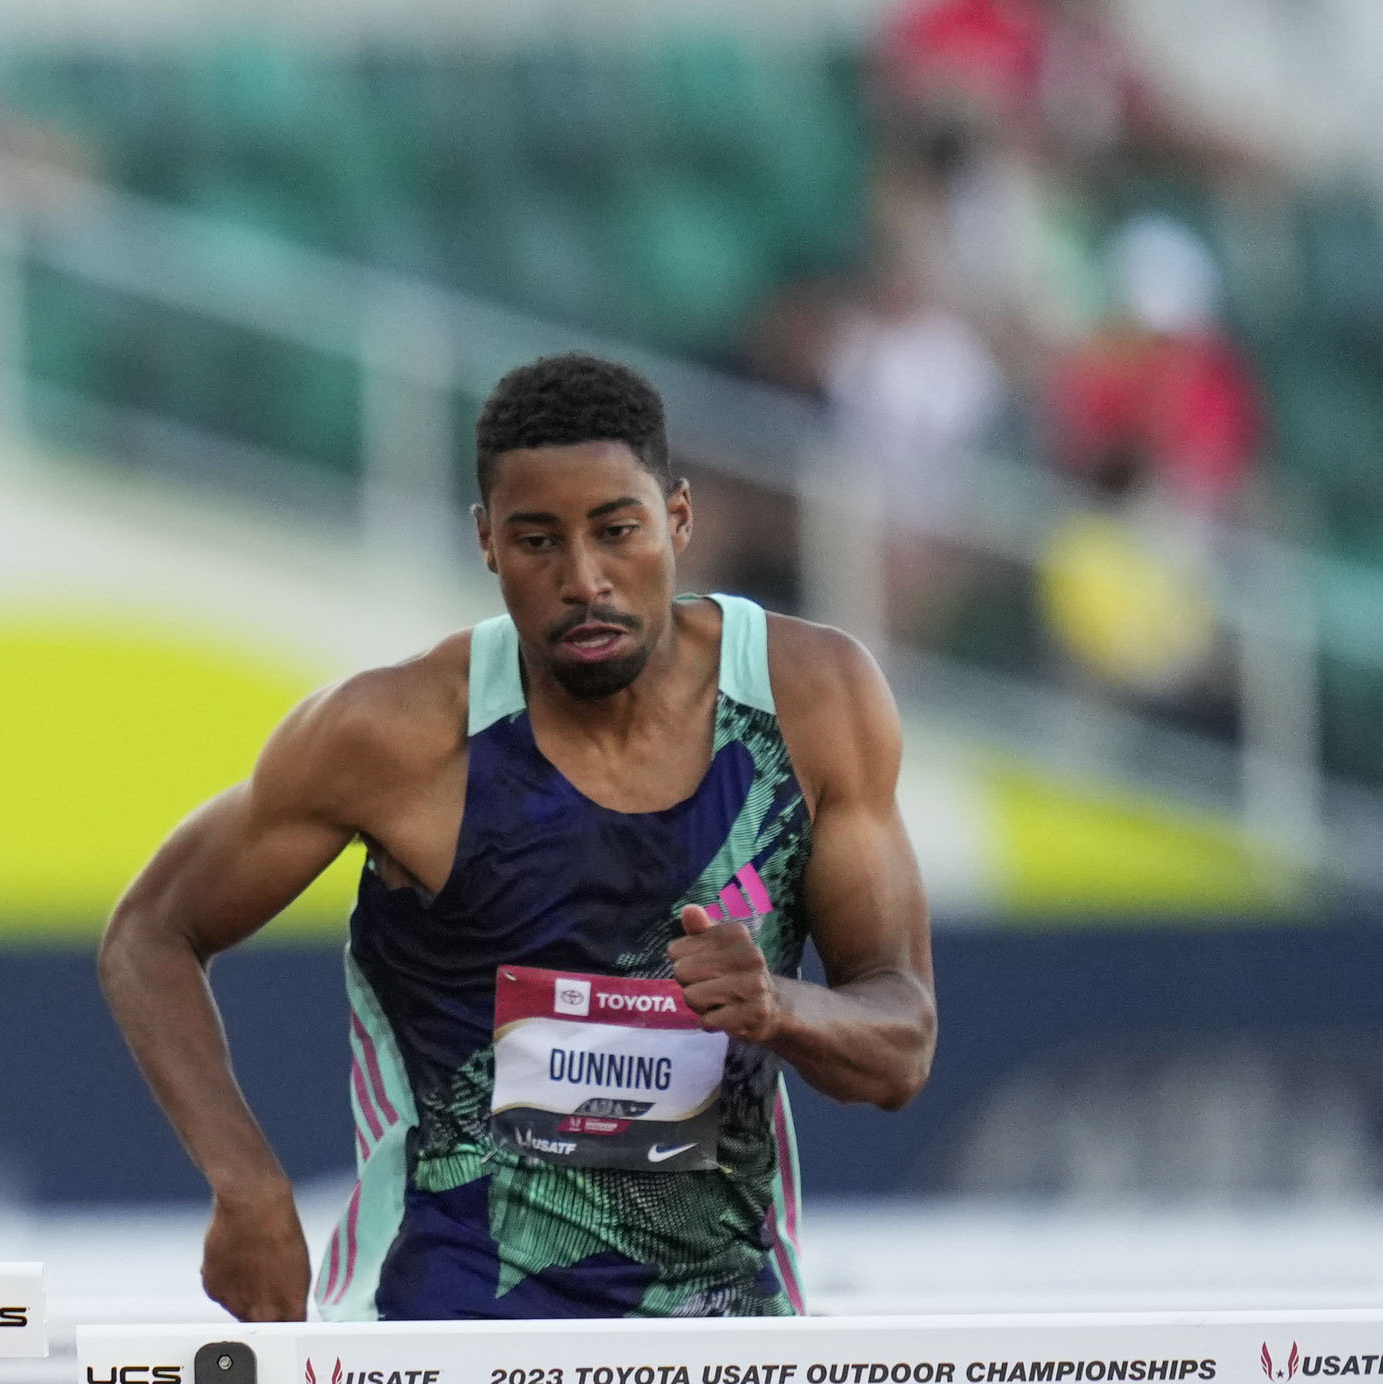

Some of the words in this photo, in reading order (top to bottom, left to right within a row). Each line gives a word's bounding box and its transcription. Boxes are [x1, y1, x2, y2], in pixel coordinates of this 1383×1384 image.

[596, 992, 678, 1013] TOYOTA
[549, 1048, 673, 1091] DUNNING
[806, 1361, 956, 1384] OUTDOOR
[966, 1359, 1218, 1383] CHAMPIONSHIPS
